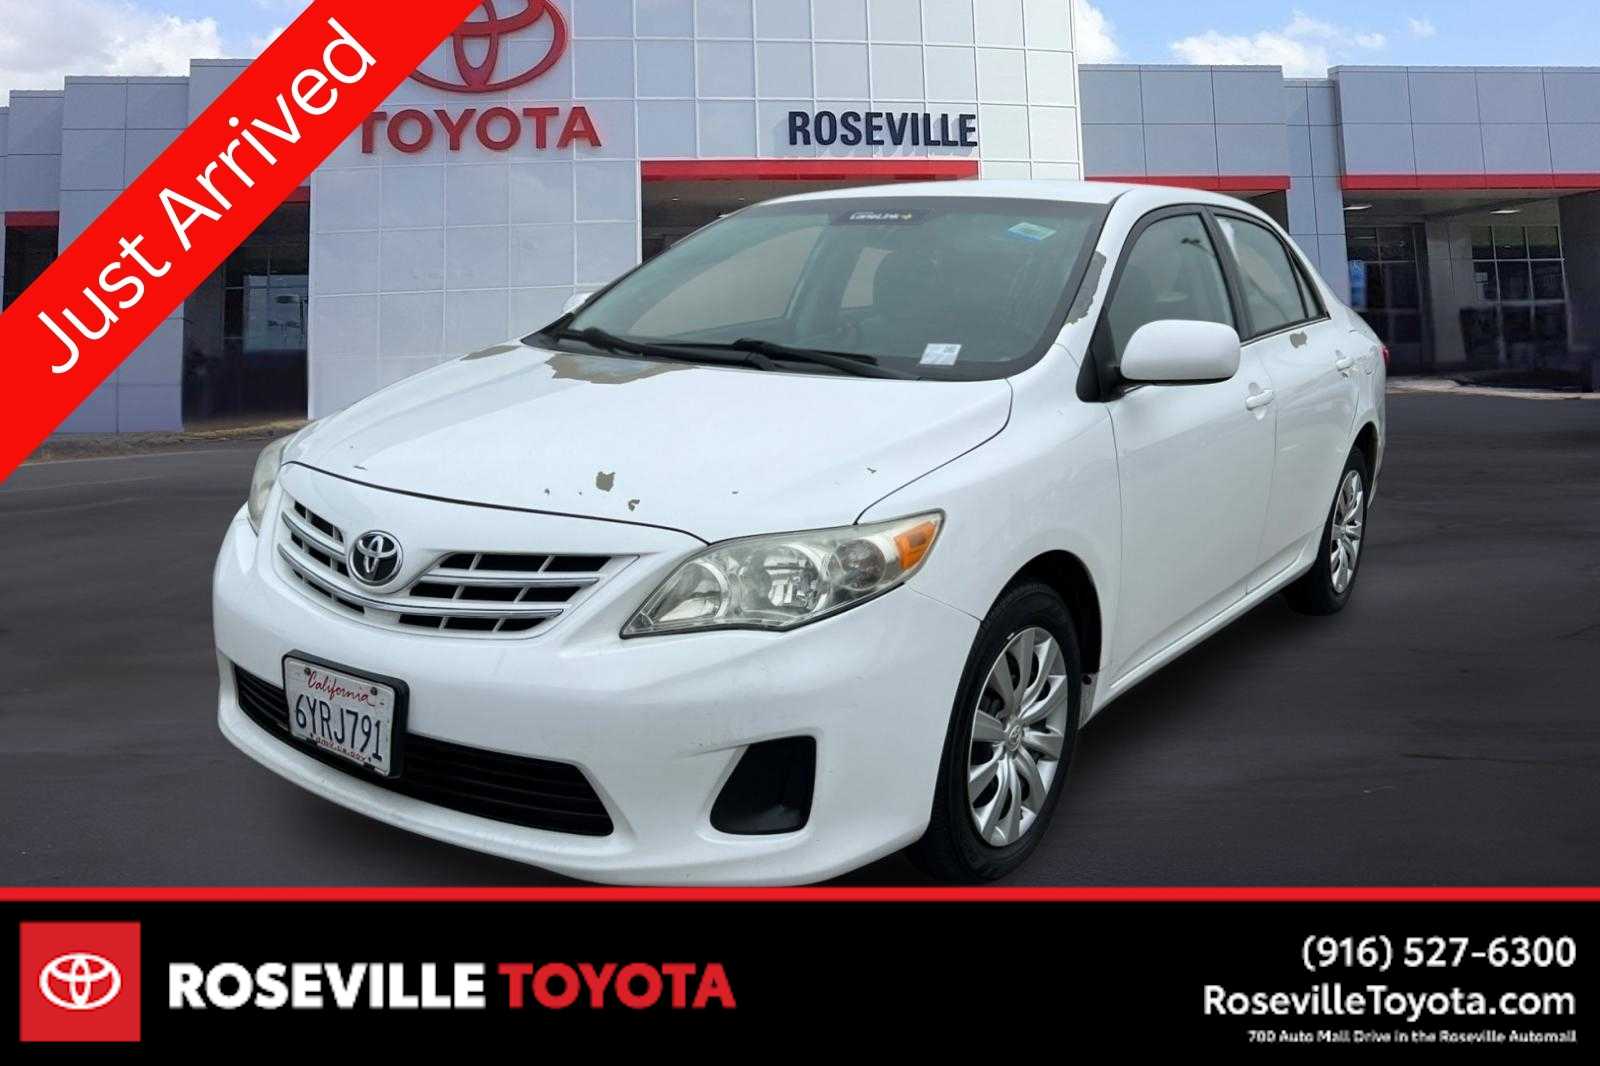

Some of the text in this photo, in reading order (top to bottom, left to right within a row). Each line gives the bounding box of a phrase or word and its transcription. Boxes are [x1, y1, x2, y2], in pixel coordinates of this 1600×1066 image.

[361, 106, 602, 154] TOYOTA
[788, 110, 978, 147] ROSEVILLE
[308, 671, 371, 706] California
[295, 694, 383, 762] 6YRJ791
